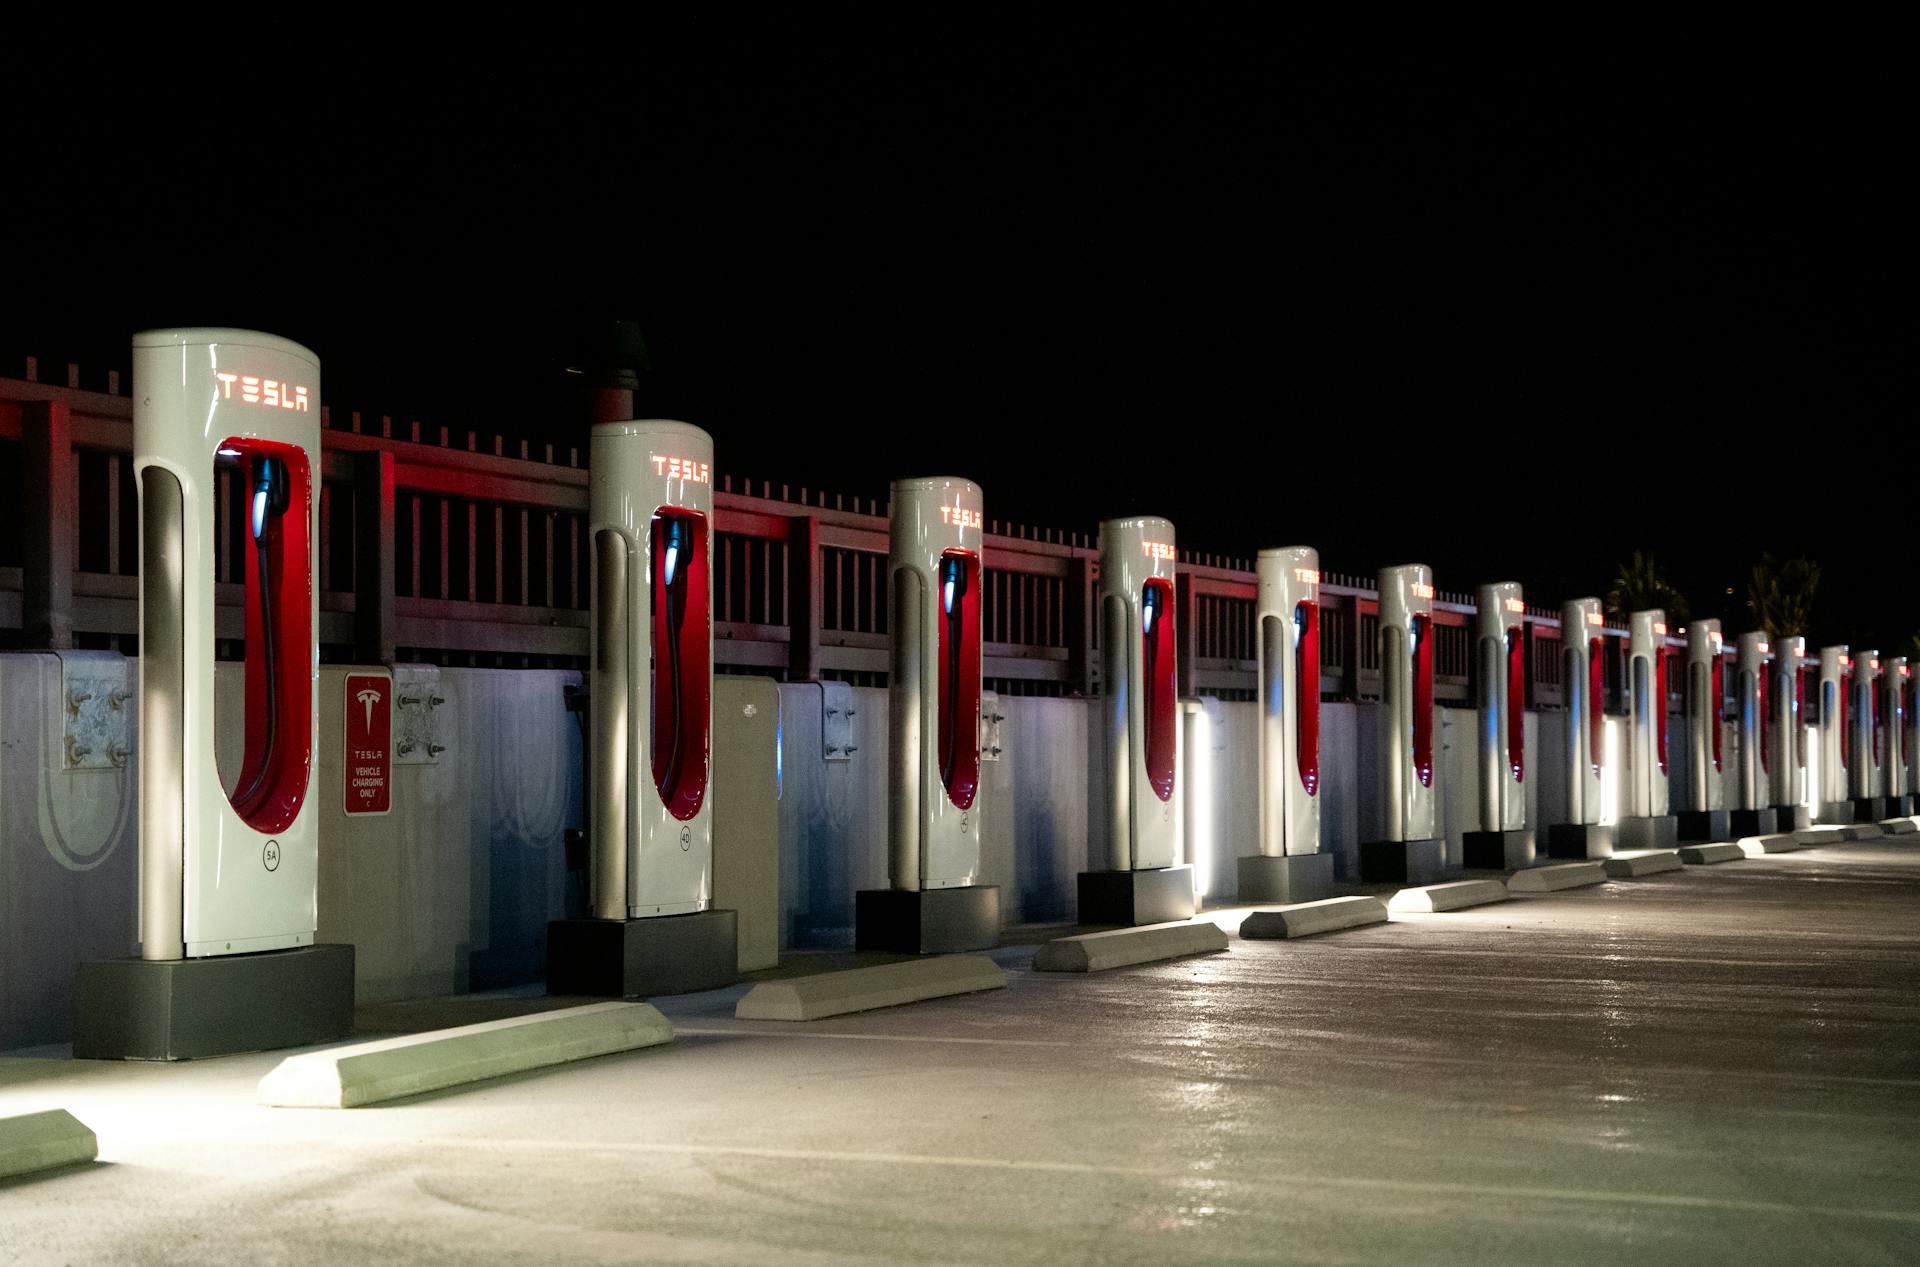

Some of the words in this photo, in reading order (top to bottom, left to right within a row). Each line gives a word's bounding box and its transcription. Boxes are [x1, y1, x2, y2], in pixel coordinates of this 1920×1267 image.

[216, 373, 308, 412] TESLA
[653, 455, 708, 483] TESLA
[941, 506, 981, 529] TESLA
[355, 750, 383, 759] TESLA
[355, 767, 380, 776] VEHICLE
[352, 778, 383, 787] CHARGING
[360, 789, 376, 798] ONLY
[266, 850, 277, 861] 5A
